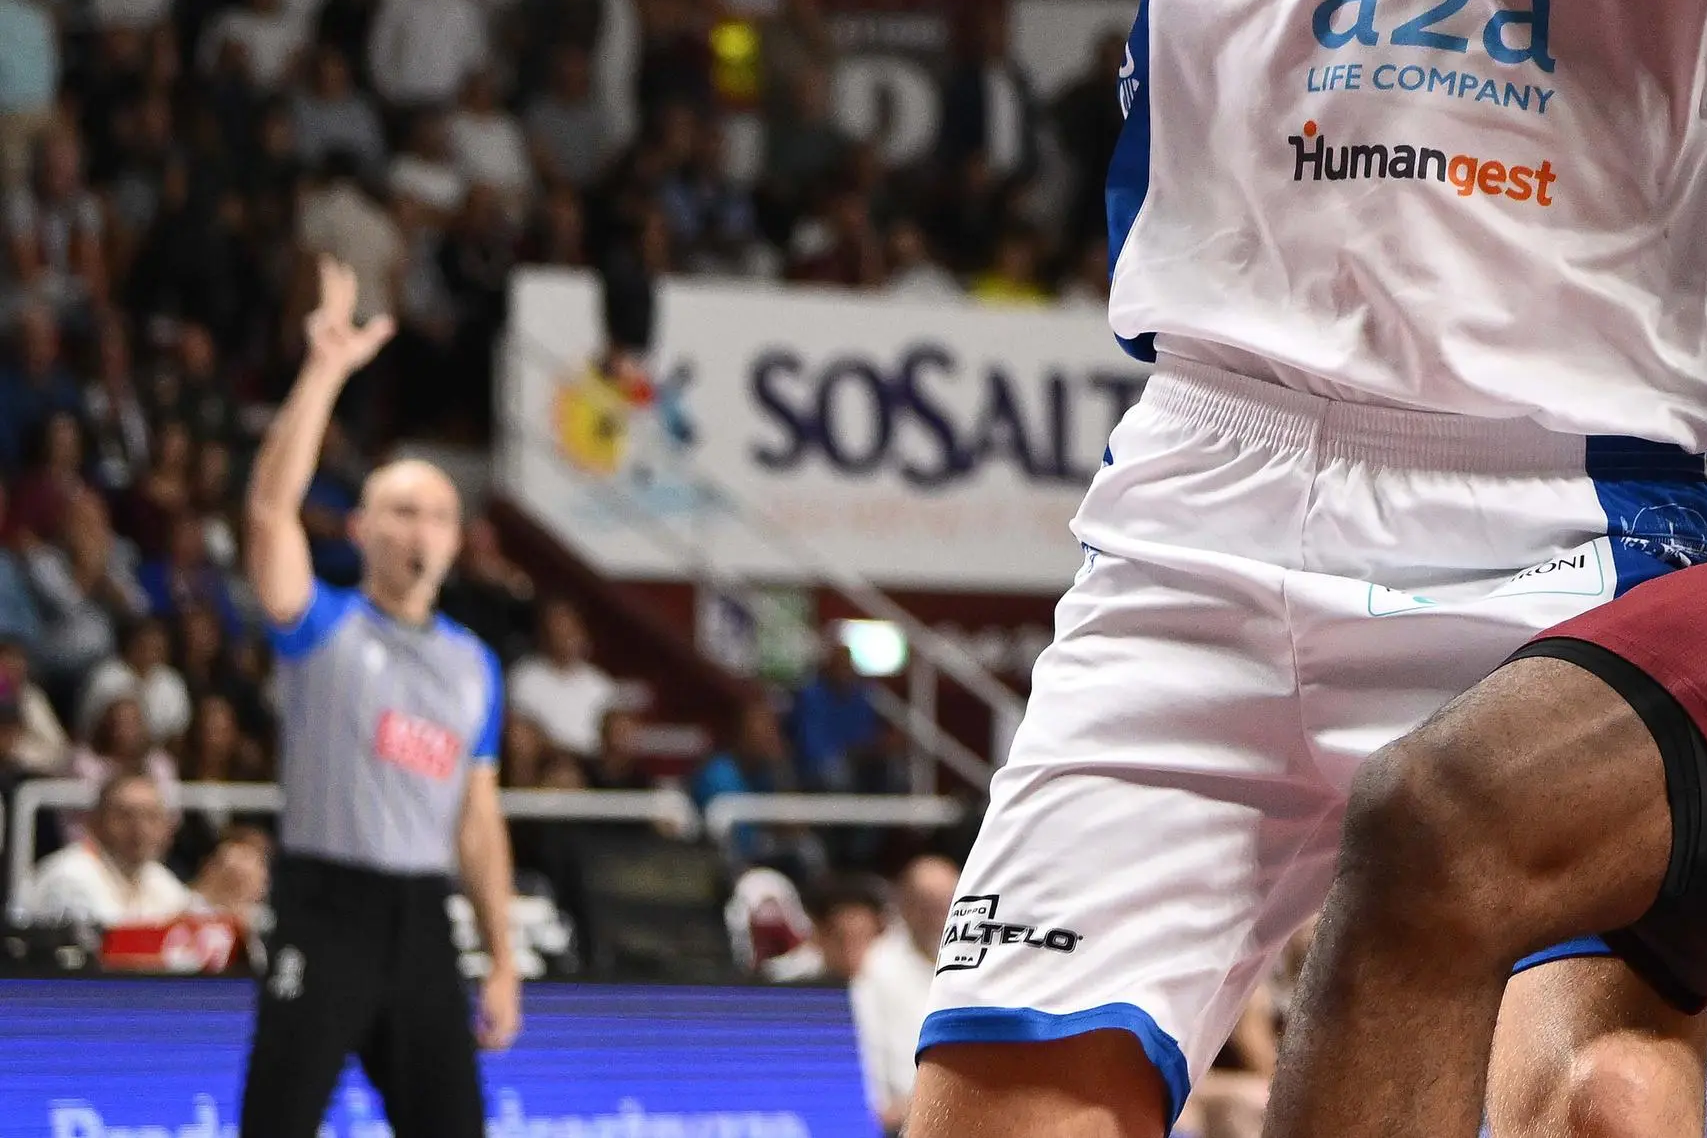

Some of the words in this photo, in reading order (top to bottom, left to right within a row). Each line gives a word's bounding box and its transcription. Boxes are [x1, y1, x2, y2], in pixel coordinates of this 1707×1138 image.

[1307, 64, 1362, 93] LIFE
[1372, 64, 1554, 114] COMPANY
[1288, 120, 1557, 207] Humangest
[942, 921, 1078, 954] ALTELO
